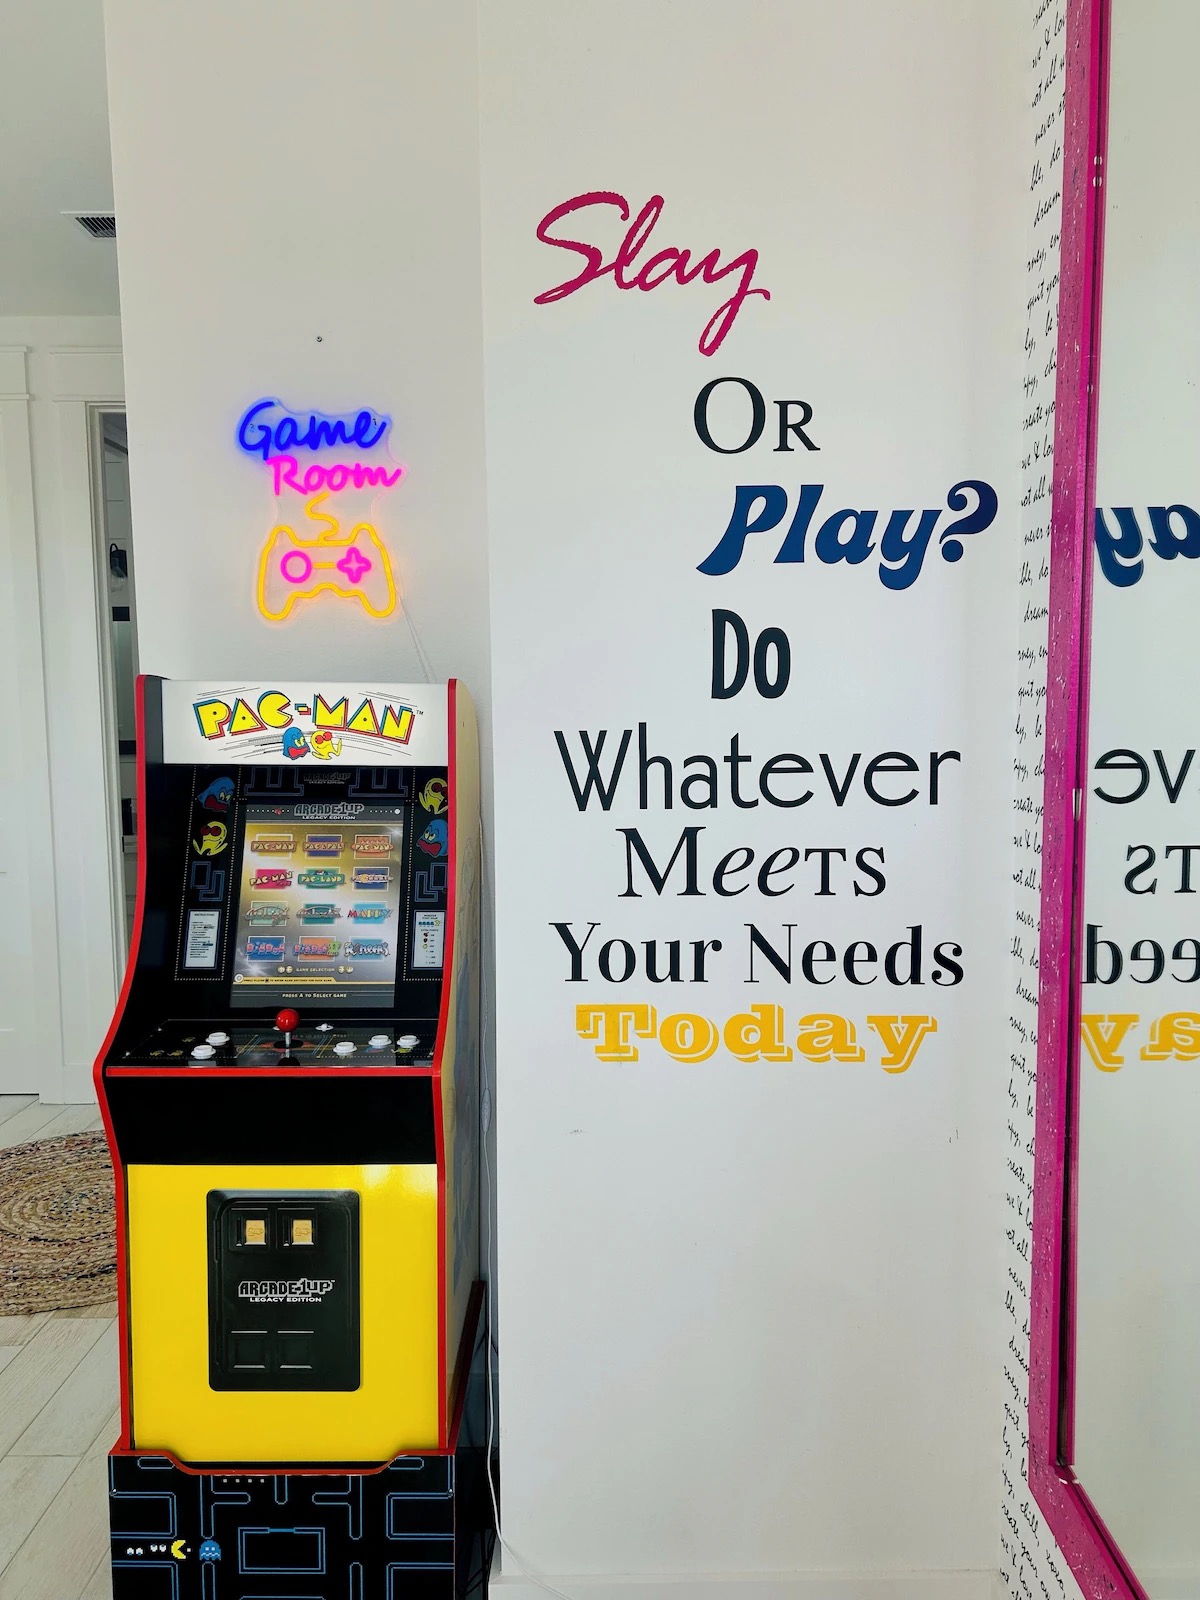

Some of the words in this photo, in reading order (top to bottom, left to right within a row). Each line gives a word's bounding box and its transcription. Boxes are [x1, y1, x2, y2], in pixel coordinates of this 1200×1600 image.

[534, 191, 770, 356] Slay
[237, 400, 389, 461] Game
[266, 455, 402, 495] Room
[696, 480, 998, 590] Play?
[711, 609, 790, 699] Do
[193, 690, 416, 745] PAC-MAN
[554, 722, 960, 811] Whatever
[549, 922, 722, 983] Your
[744, 924, 964, 986] Needs
[575, 1003, 938, 1074] Today
